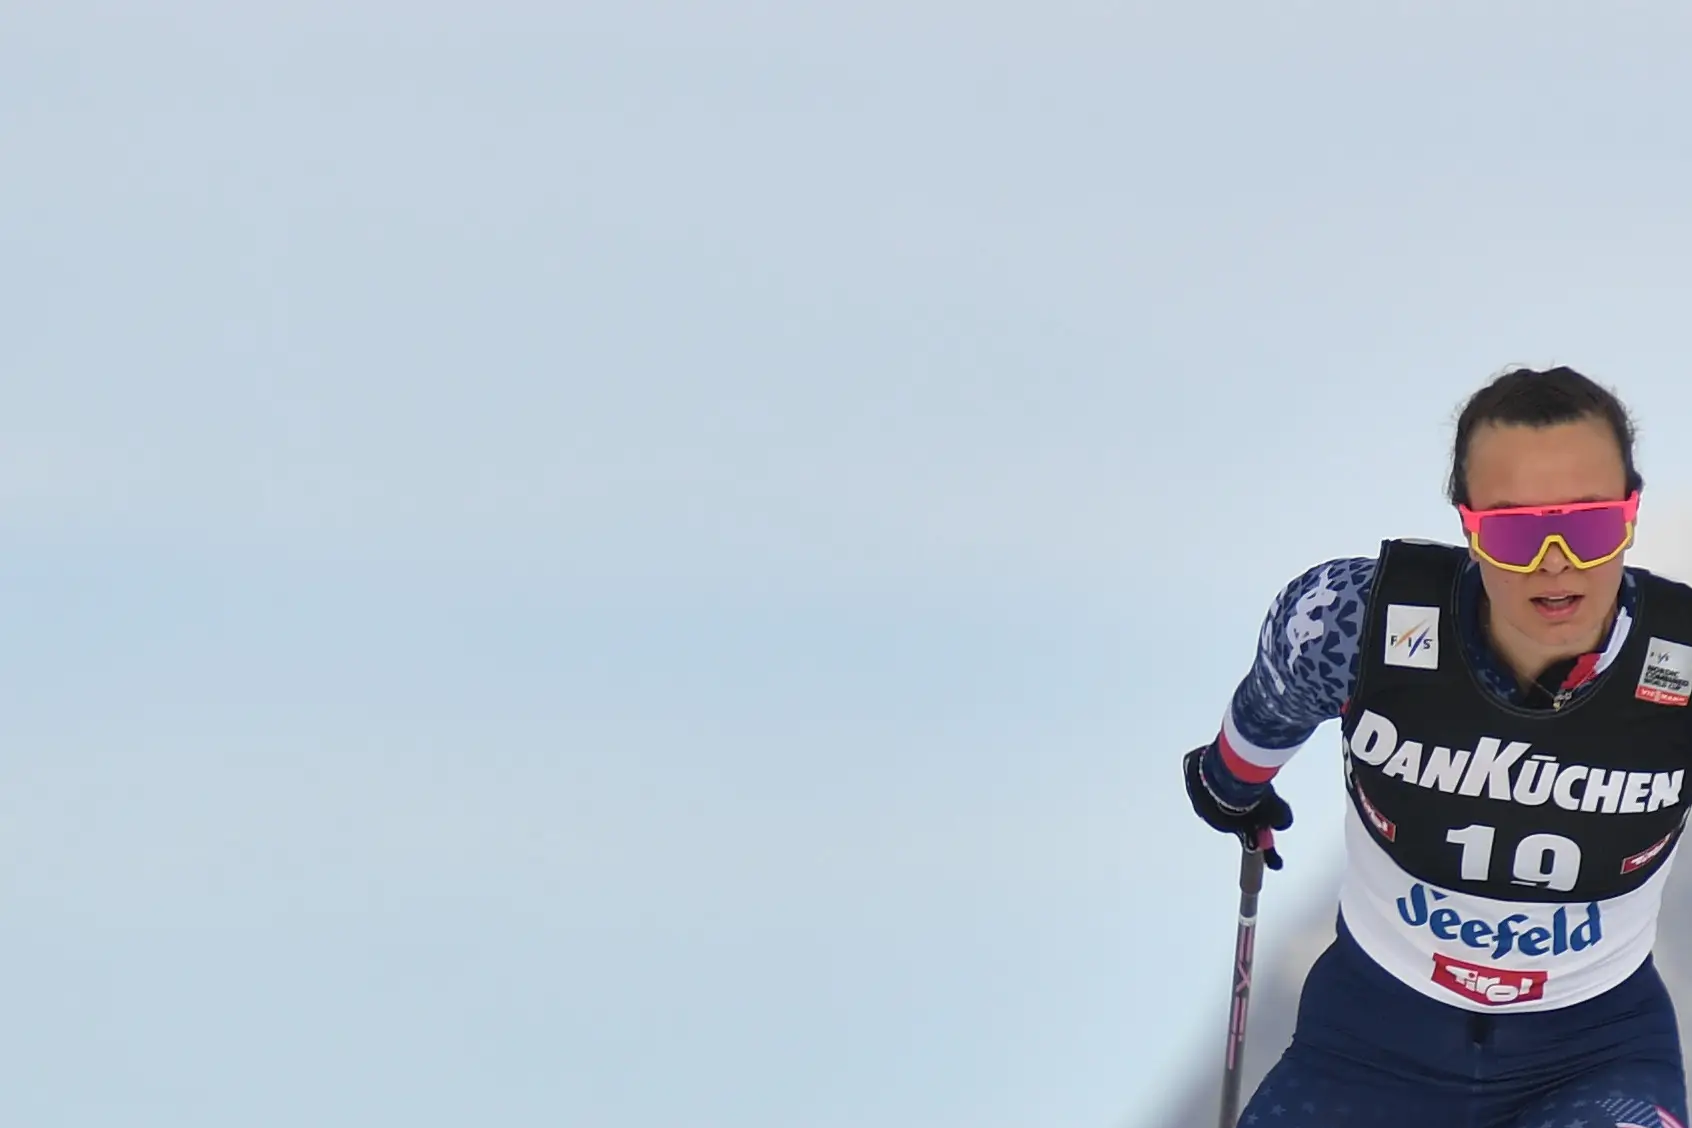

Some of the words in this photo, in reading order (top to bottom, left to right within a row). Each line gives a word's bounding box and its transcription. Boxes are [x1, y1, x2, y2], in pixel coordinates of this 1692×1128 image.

[1446, 823, 1583, 892] 19
[1397, 883, 1603, 960] Seefeld
[1445, 965, 1533, 1002] Tirol
